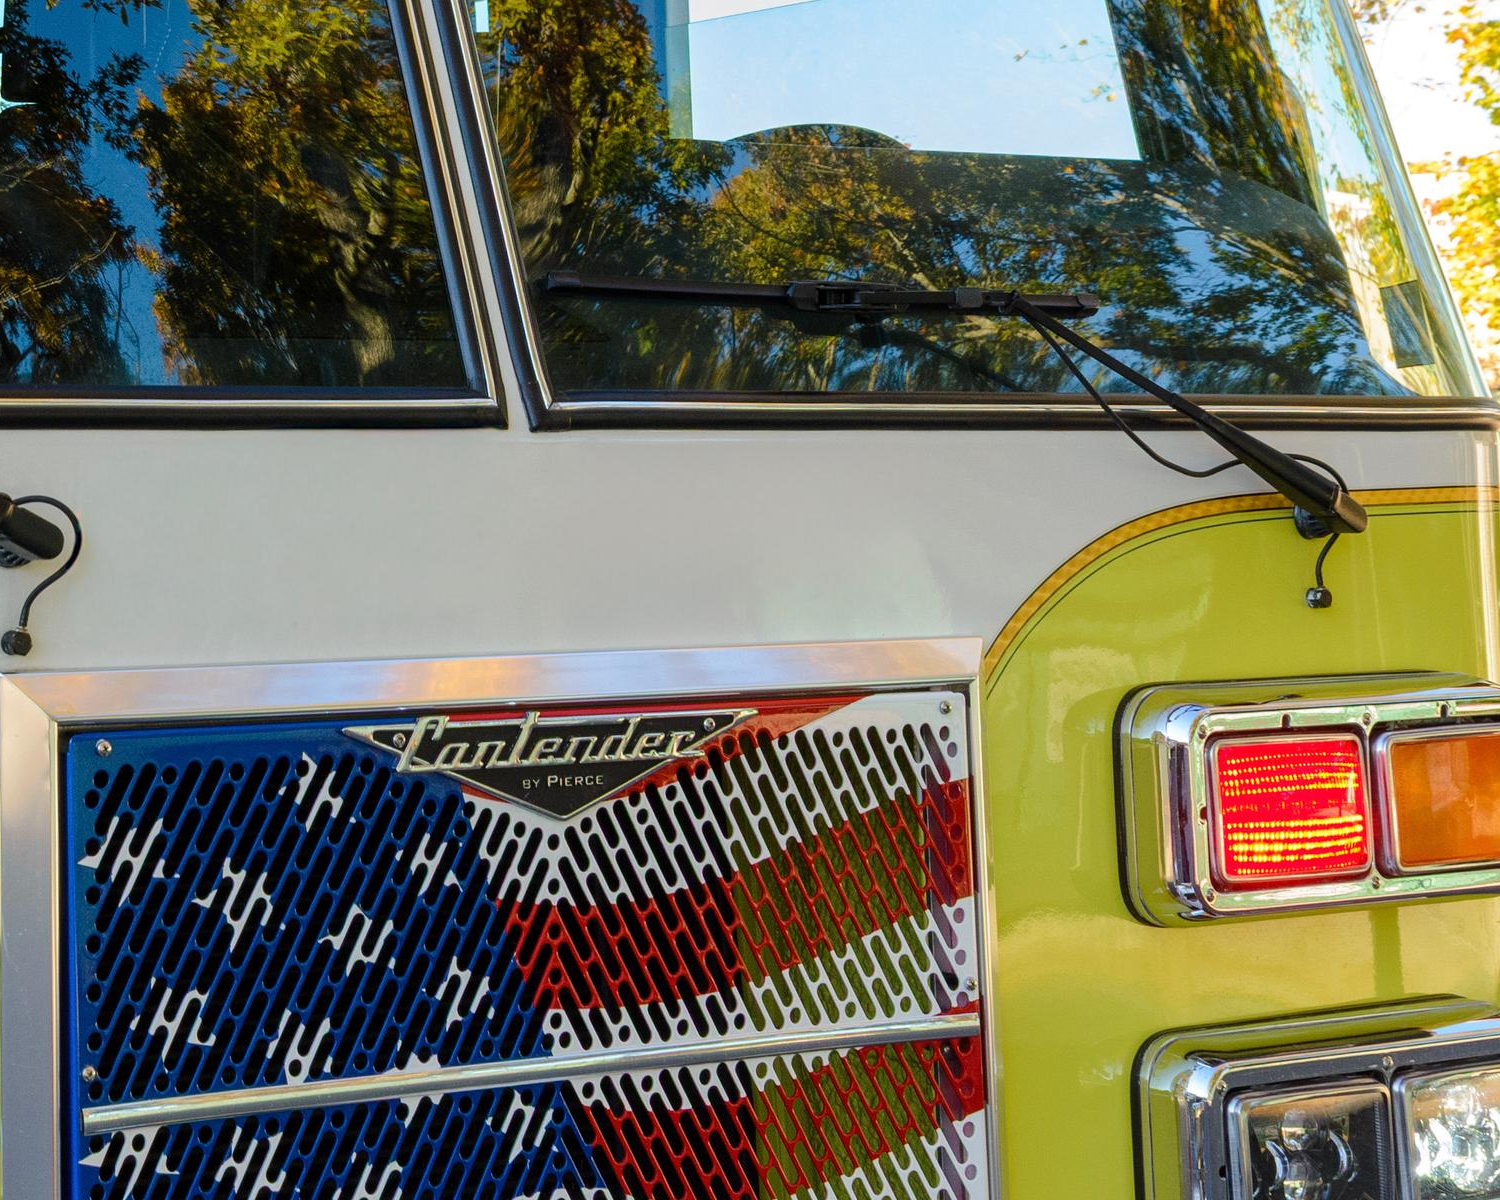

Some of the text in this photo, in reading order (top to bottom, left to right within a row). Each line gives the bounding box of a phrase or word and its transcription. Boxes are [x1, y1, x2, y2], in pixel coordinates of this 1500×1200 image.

[396, 710, 706, 773] Contender
[522, 774, 605, 790] BY PIERCE
